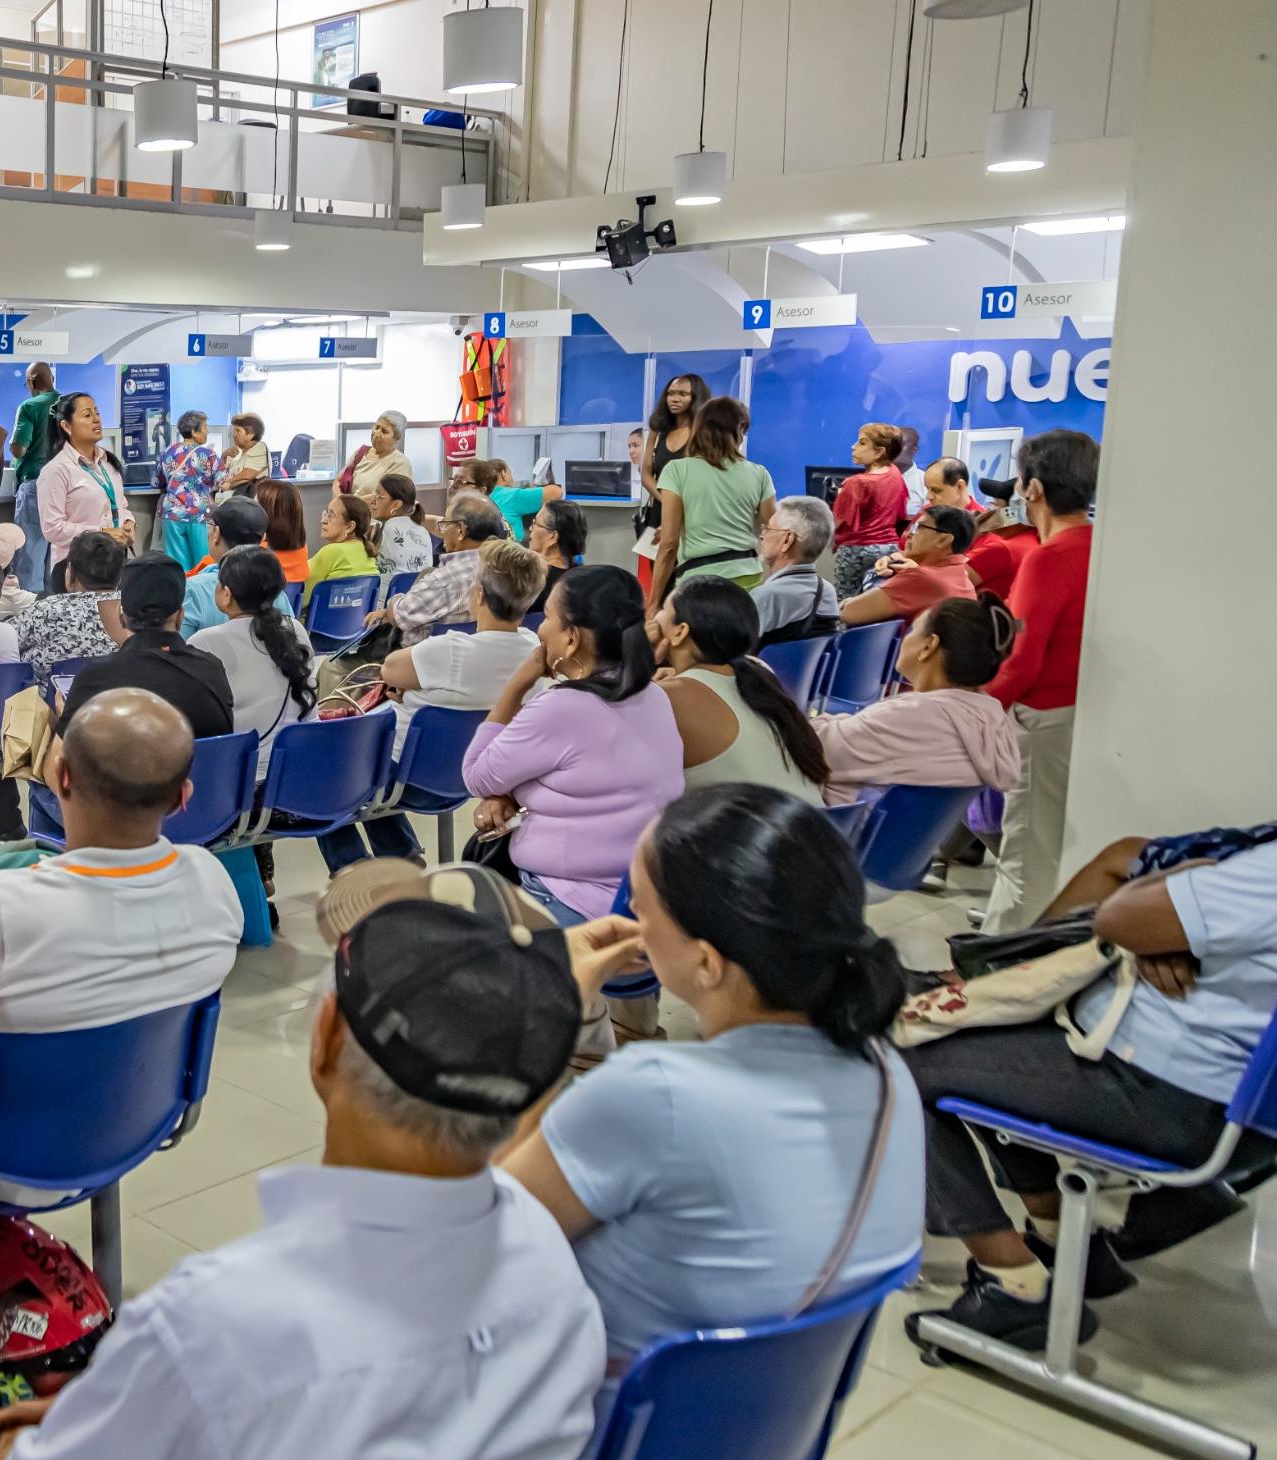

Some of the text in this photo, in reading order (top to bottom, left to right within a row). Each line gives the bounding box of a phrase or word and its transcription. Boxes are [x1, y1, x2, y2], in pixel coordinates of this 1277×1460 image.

[985, 291, 1073, 314] 10 Asesor
[751, 305, 814, 324] 9 Asesor
[489, 316, 539, 334] 8 Asesor
[0, 334, 43, 350] 5 Asesor
[193, 338, 200, 353] 6
[324, 340, 331, 355] 7
